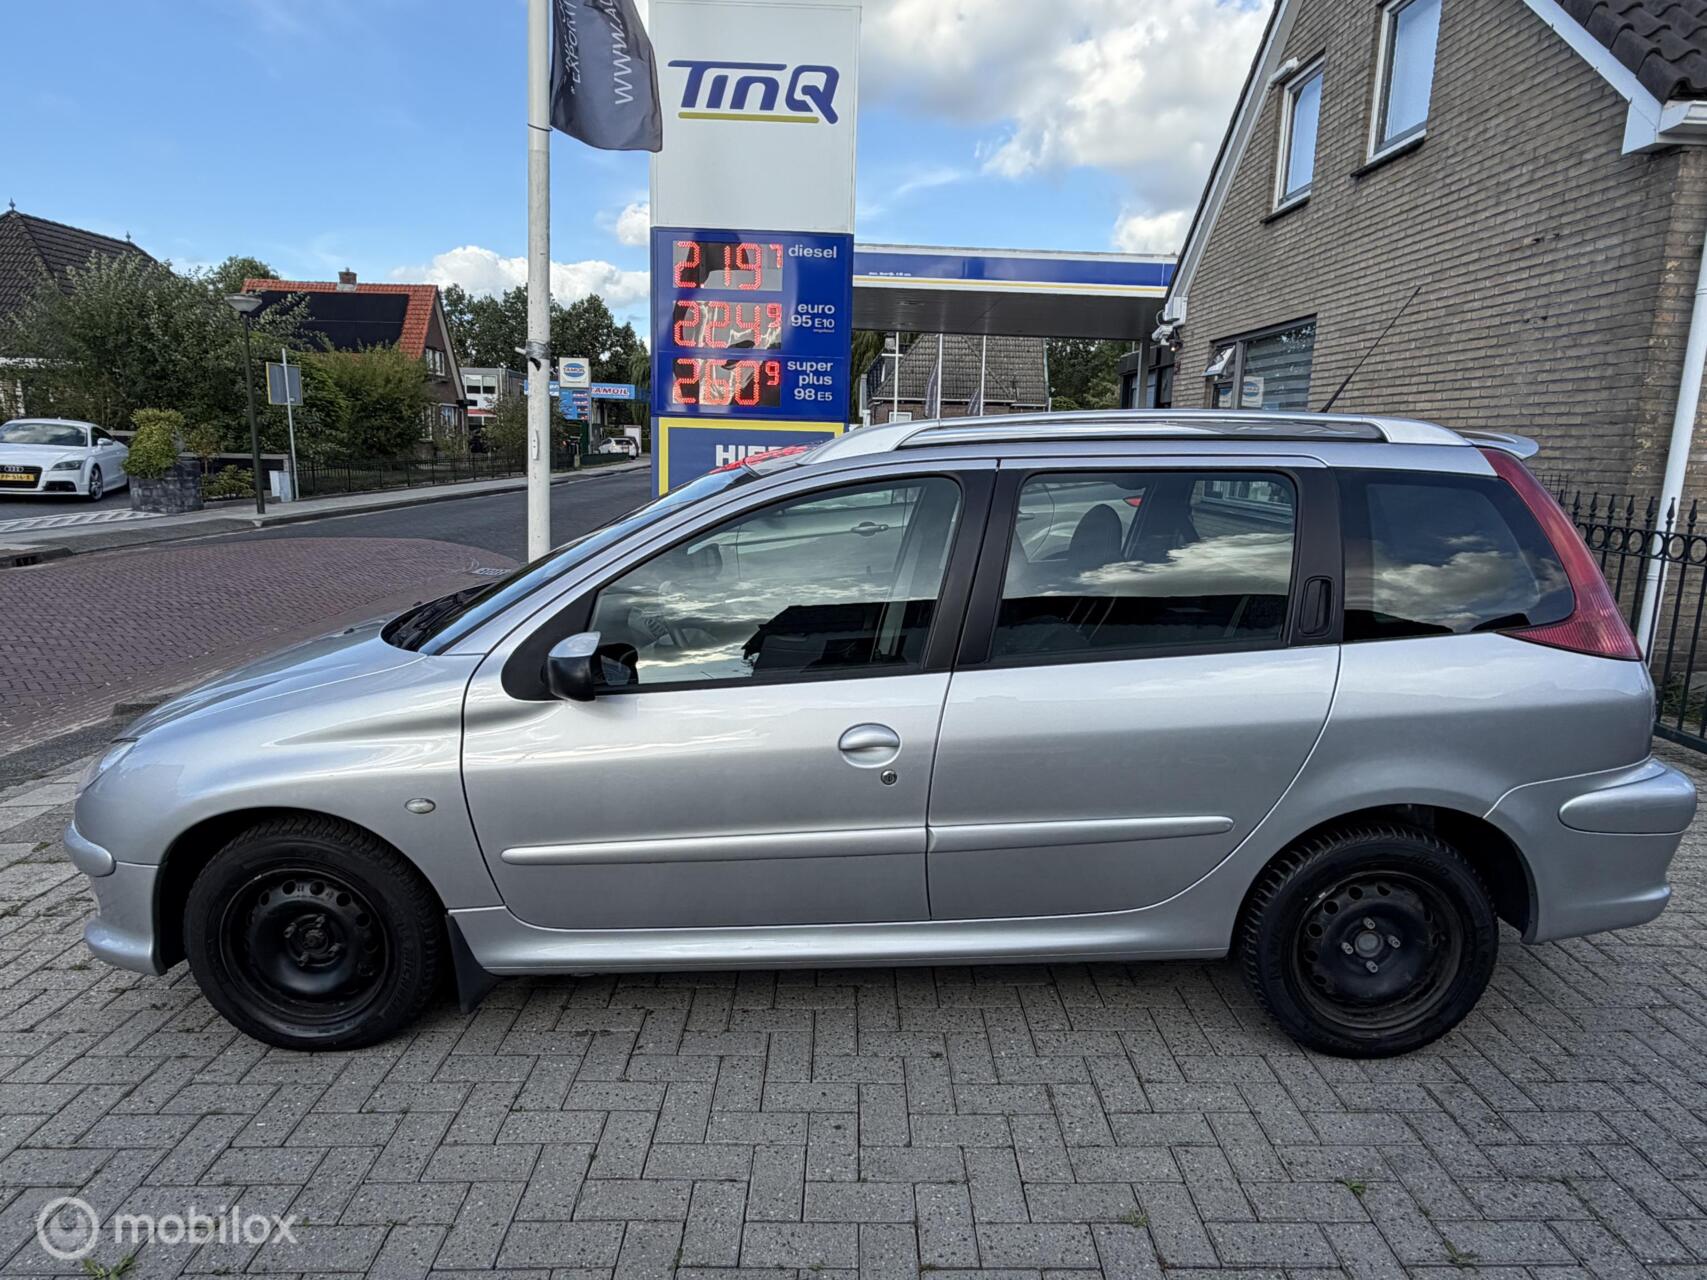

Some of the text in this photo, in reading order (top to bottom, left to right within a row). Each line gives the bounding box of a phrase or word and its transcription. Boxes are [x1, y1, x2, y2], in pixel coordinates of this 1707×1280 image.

[788, 244, 837, 258] diesel
[797, 304, 835, 313] euro
[790, 316, 812, 327] 95
[815, 319, 835, 328] E10
[787, 361, 834, 375] super
[798, 371, 833, 386] plus
[794, 388, 833, 401] 98 E5
